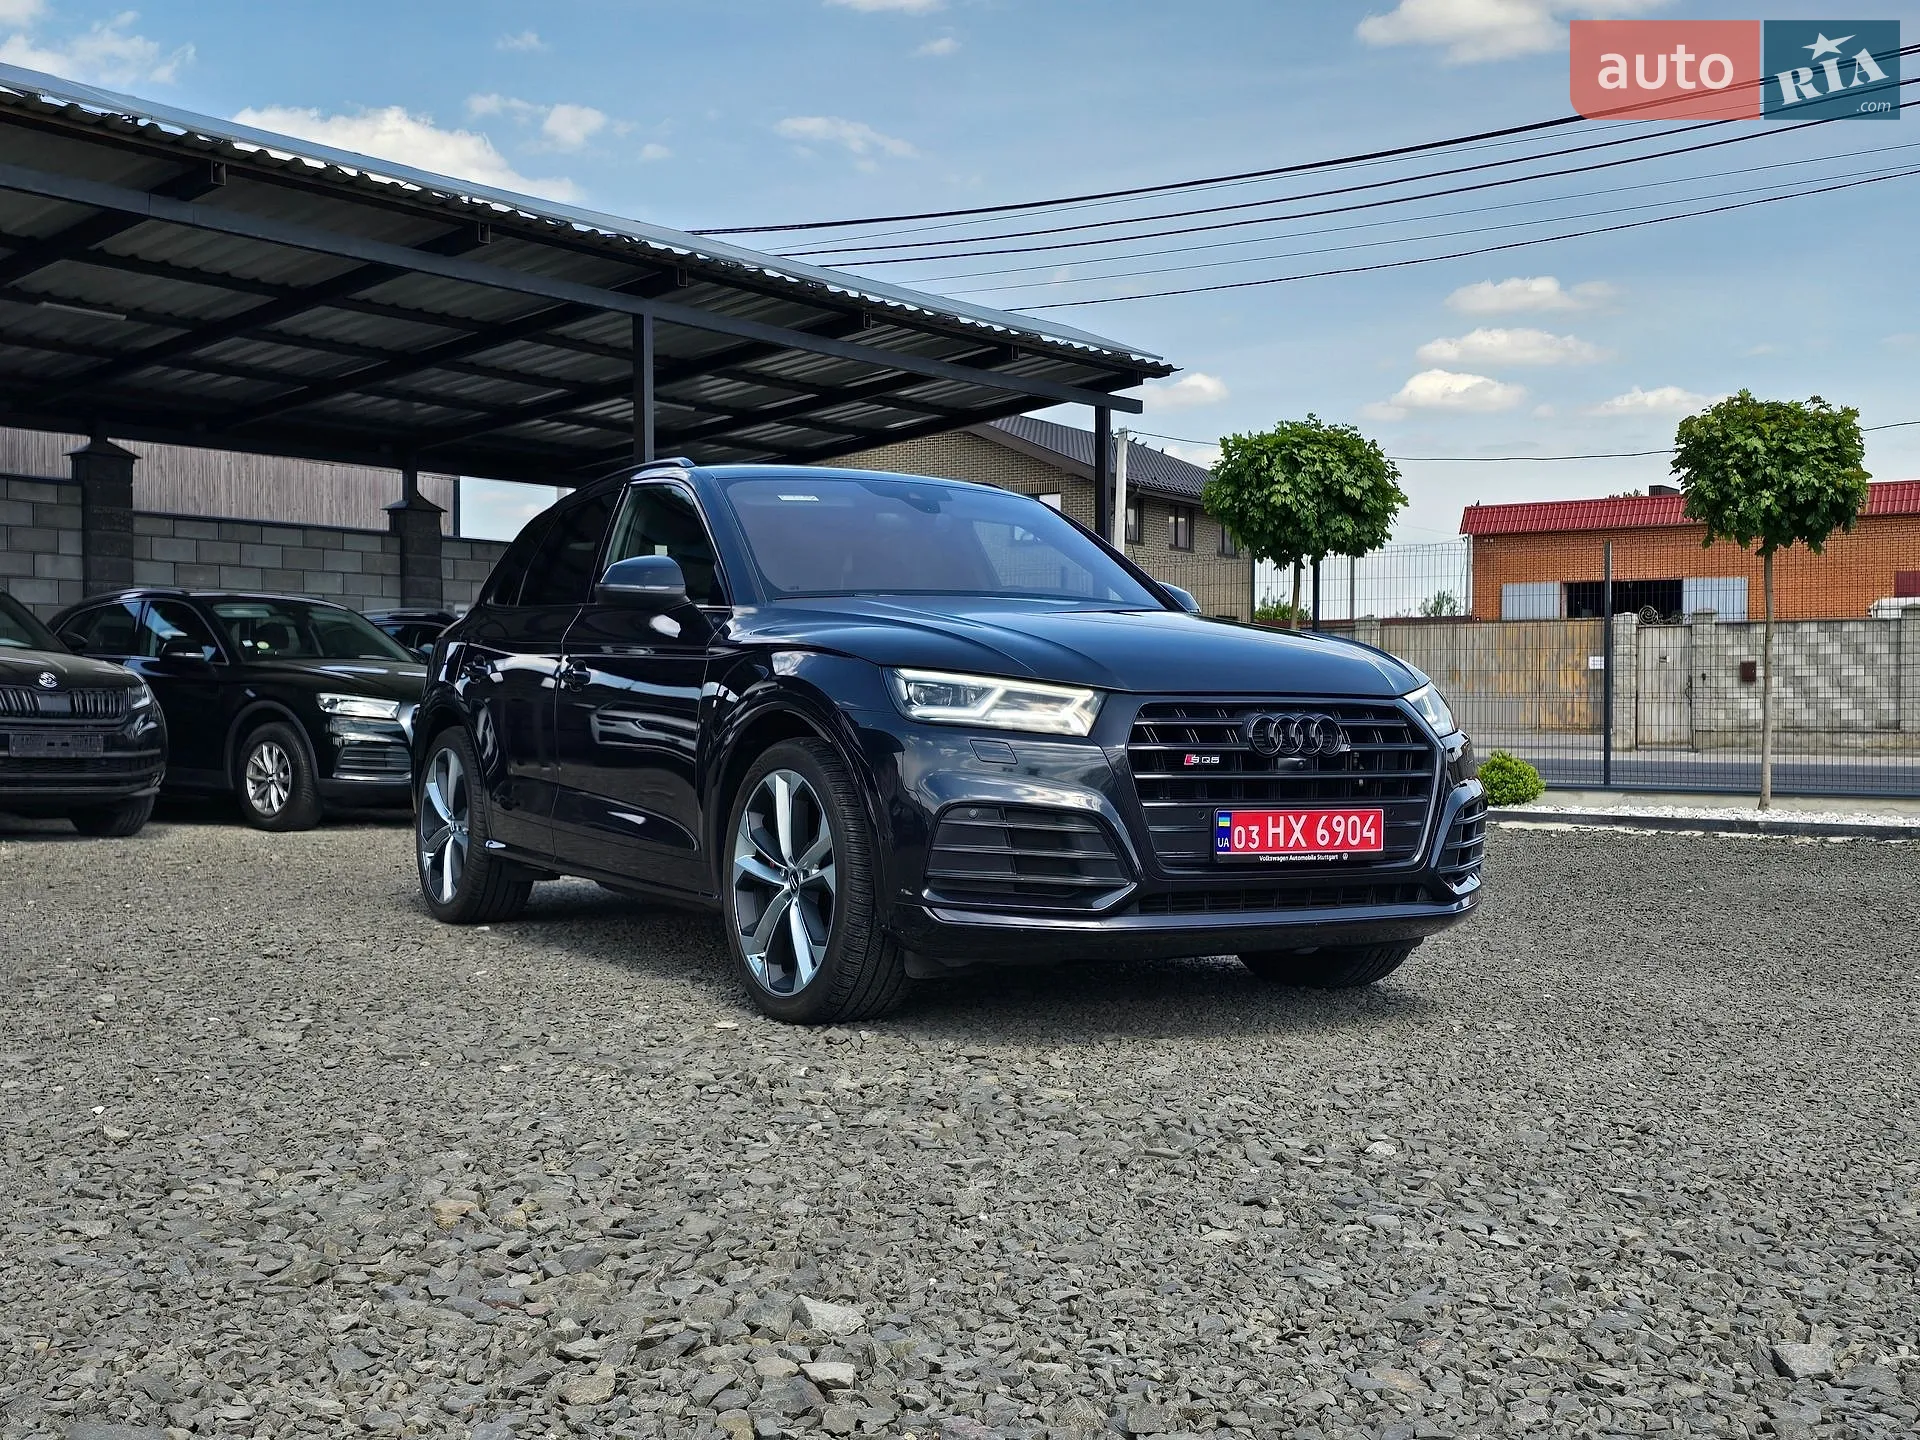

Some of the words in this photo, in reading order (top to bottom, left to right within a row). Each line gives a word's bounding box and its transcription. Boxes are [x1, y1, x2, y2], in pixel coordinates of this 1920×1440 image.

[1186, 754, 1220, 765] SQ5
[1233, 825, 1260, 849] 03
[1267, 814, 1308, 848] HX
[1316, 814, 1376, 847] 6904
[1217, 837, 1230, 848] UA
